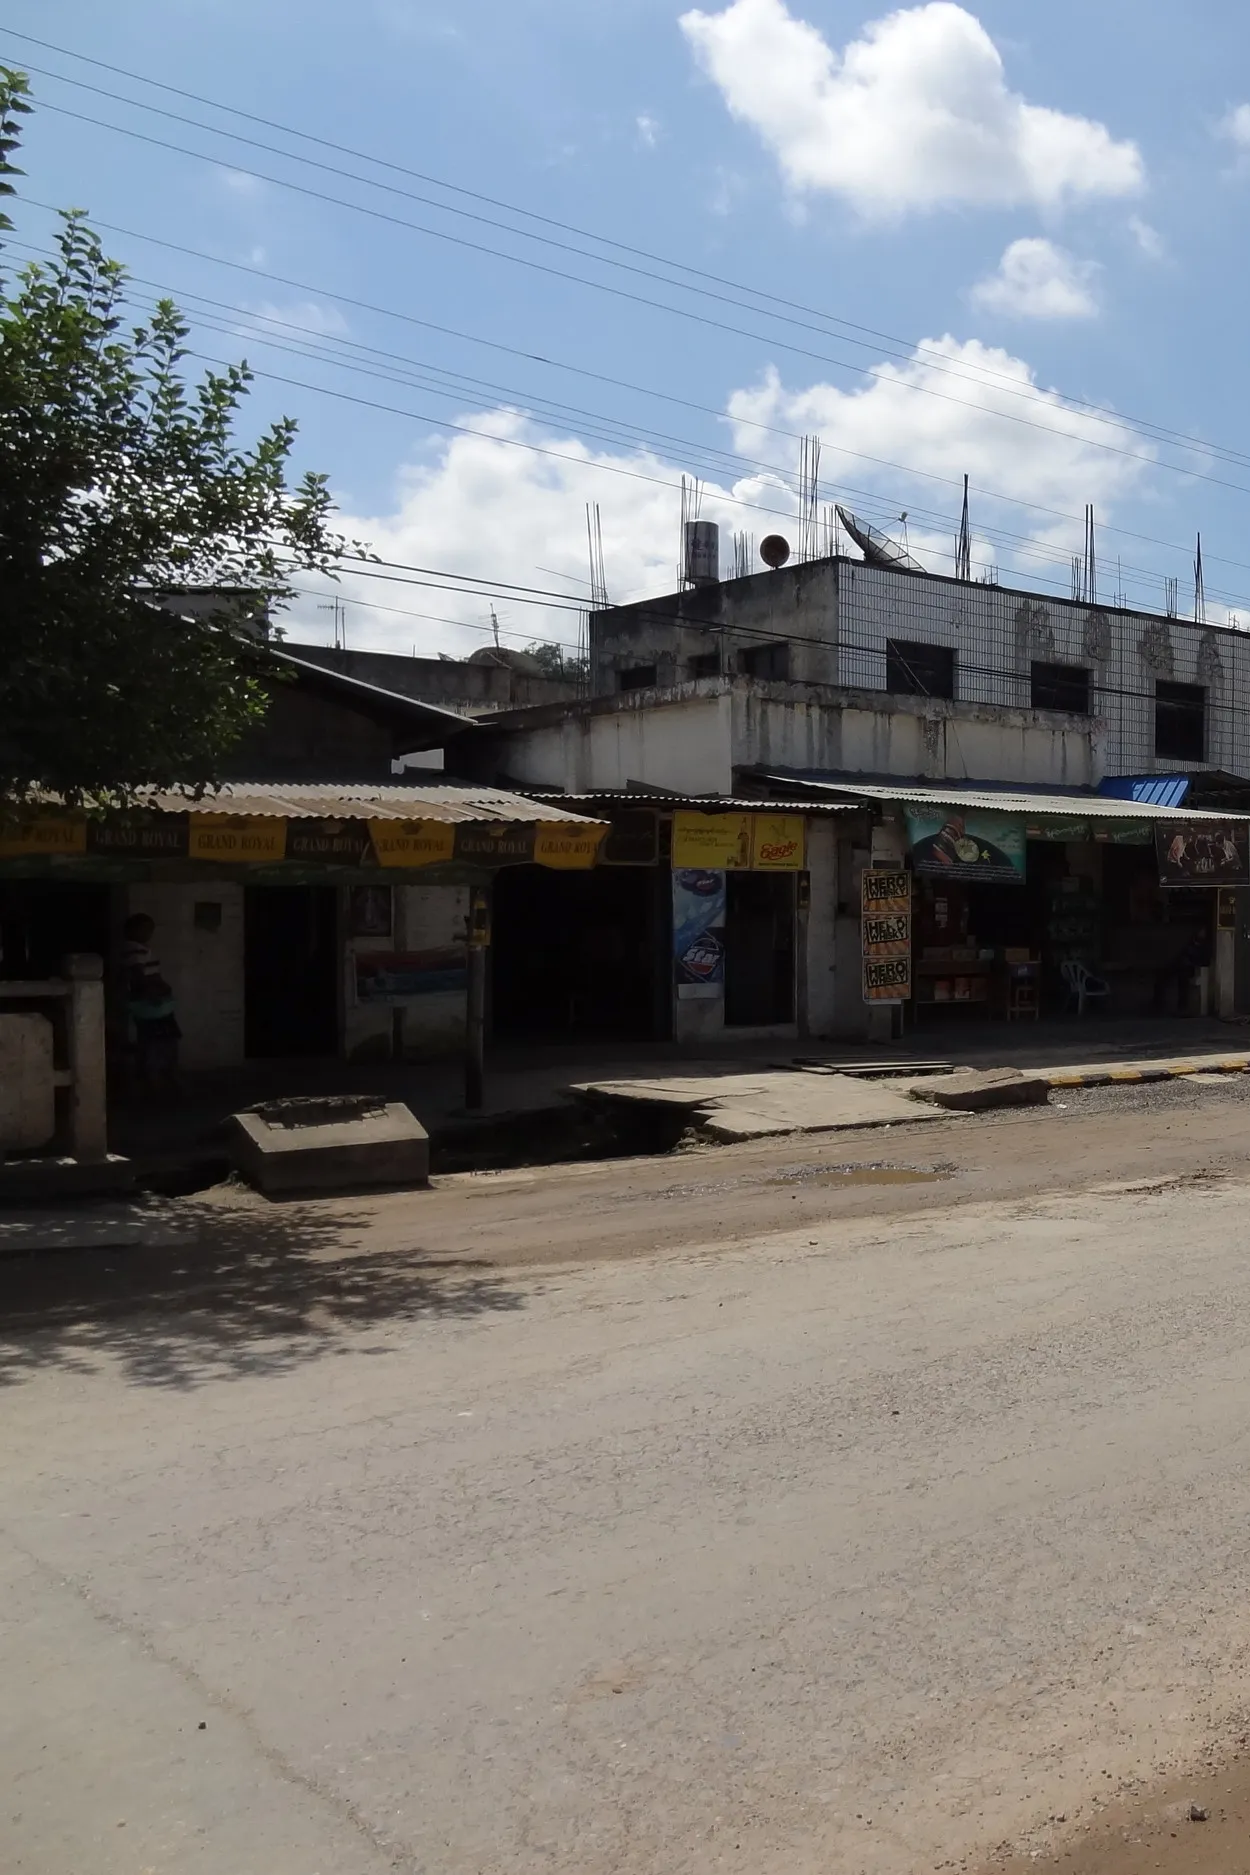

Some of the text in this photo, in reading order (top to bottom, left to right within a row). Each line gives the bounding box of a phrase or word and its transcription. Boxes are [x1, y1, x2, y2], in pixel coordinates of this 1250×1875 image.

[96, 828, 181, 848] GRAND ROYAL
[197, 833, 276, 851] GRAND ROYAL
[293, 836, 329, 853] GRAND
[413, 838, 445, 852] ROYAL
[460, 838, 527, 854] GRAND ROYAL
[540, 839, 573, 854] GRAND
[759, 841, 799, 861] Eagle
[868, 876, 906, 890] HERO
[869, 888, 907, 898] WHISKY
[869, 931, 906, 942] WHISKY
[682, 948, 721, 965] Star
[868, 962, 906, 976] HERO
[869, 974, 906, 985] WHISKY
